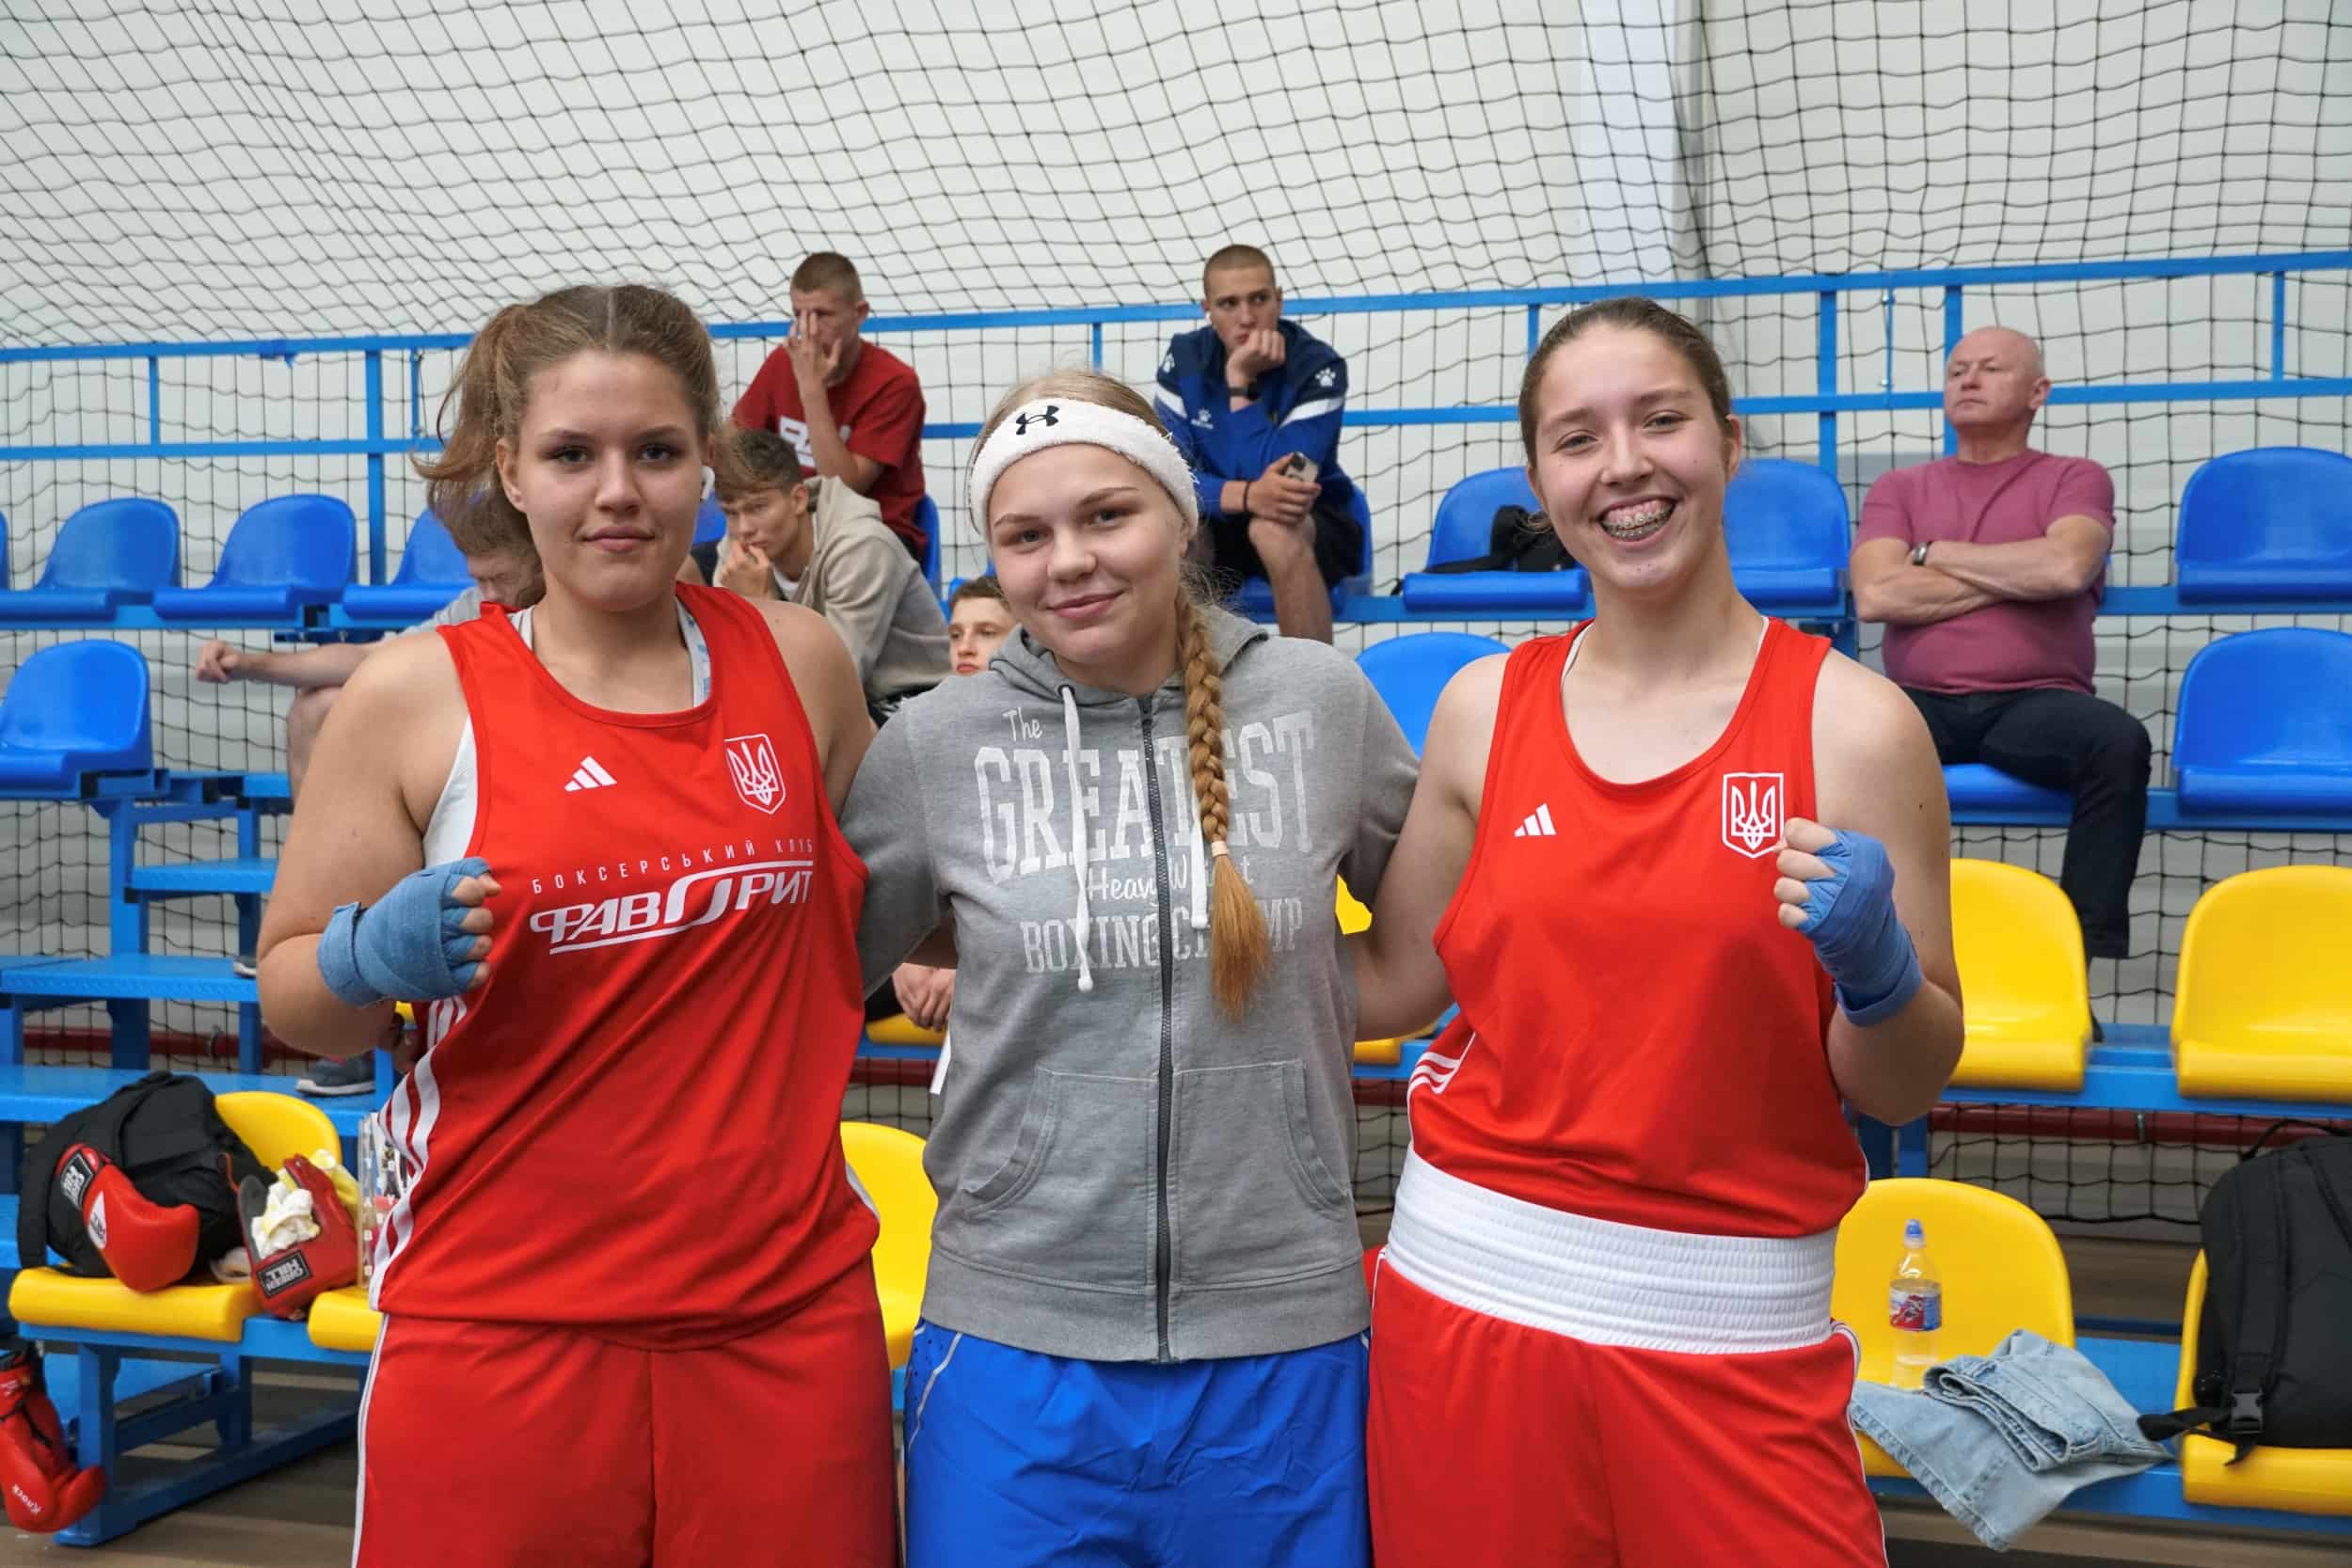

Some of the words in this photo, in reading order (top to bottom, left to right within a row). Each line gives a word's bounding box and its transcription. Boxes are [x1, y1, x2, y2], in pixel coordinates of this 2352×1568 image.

[1002, 706, 1043, 742] The
[532, 840, 755, 895] БОКСЕРСЬКИЙ
[1088, 866, 1161, 908] Heav
[529, 861, 814, 954] ФАВОРИТ
[1171, 897, 1303, 960] CMP
